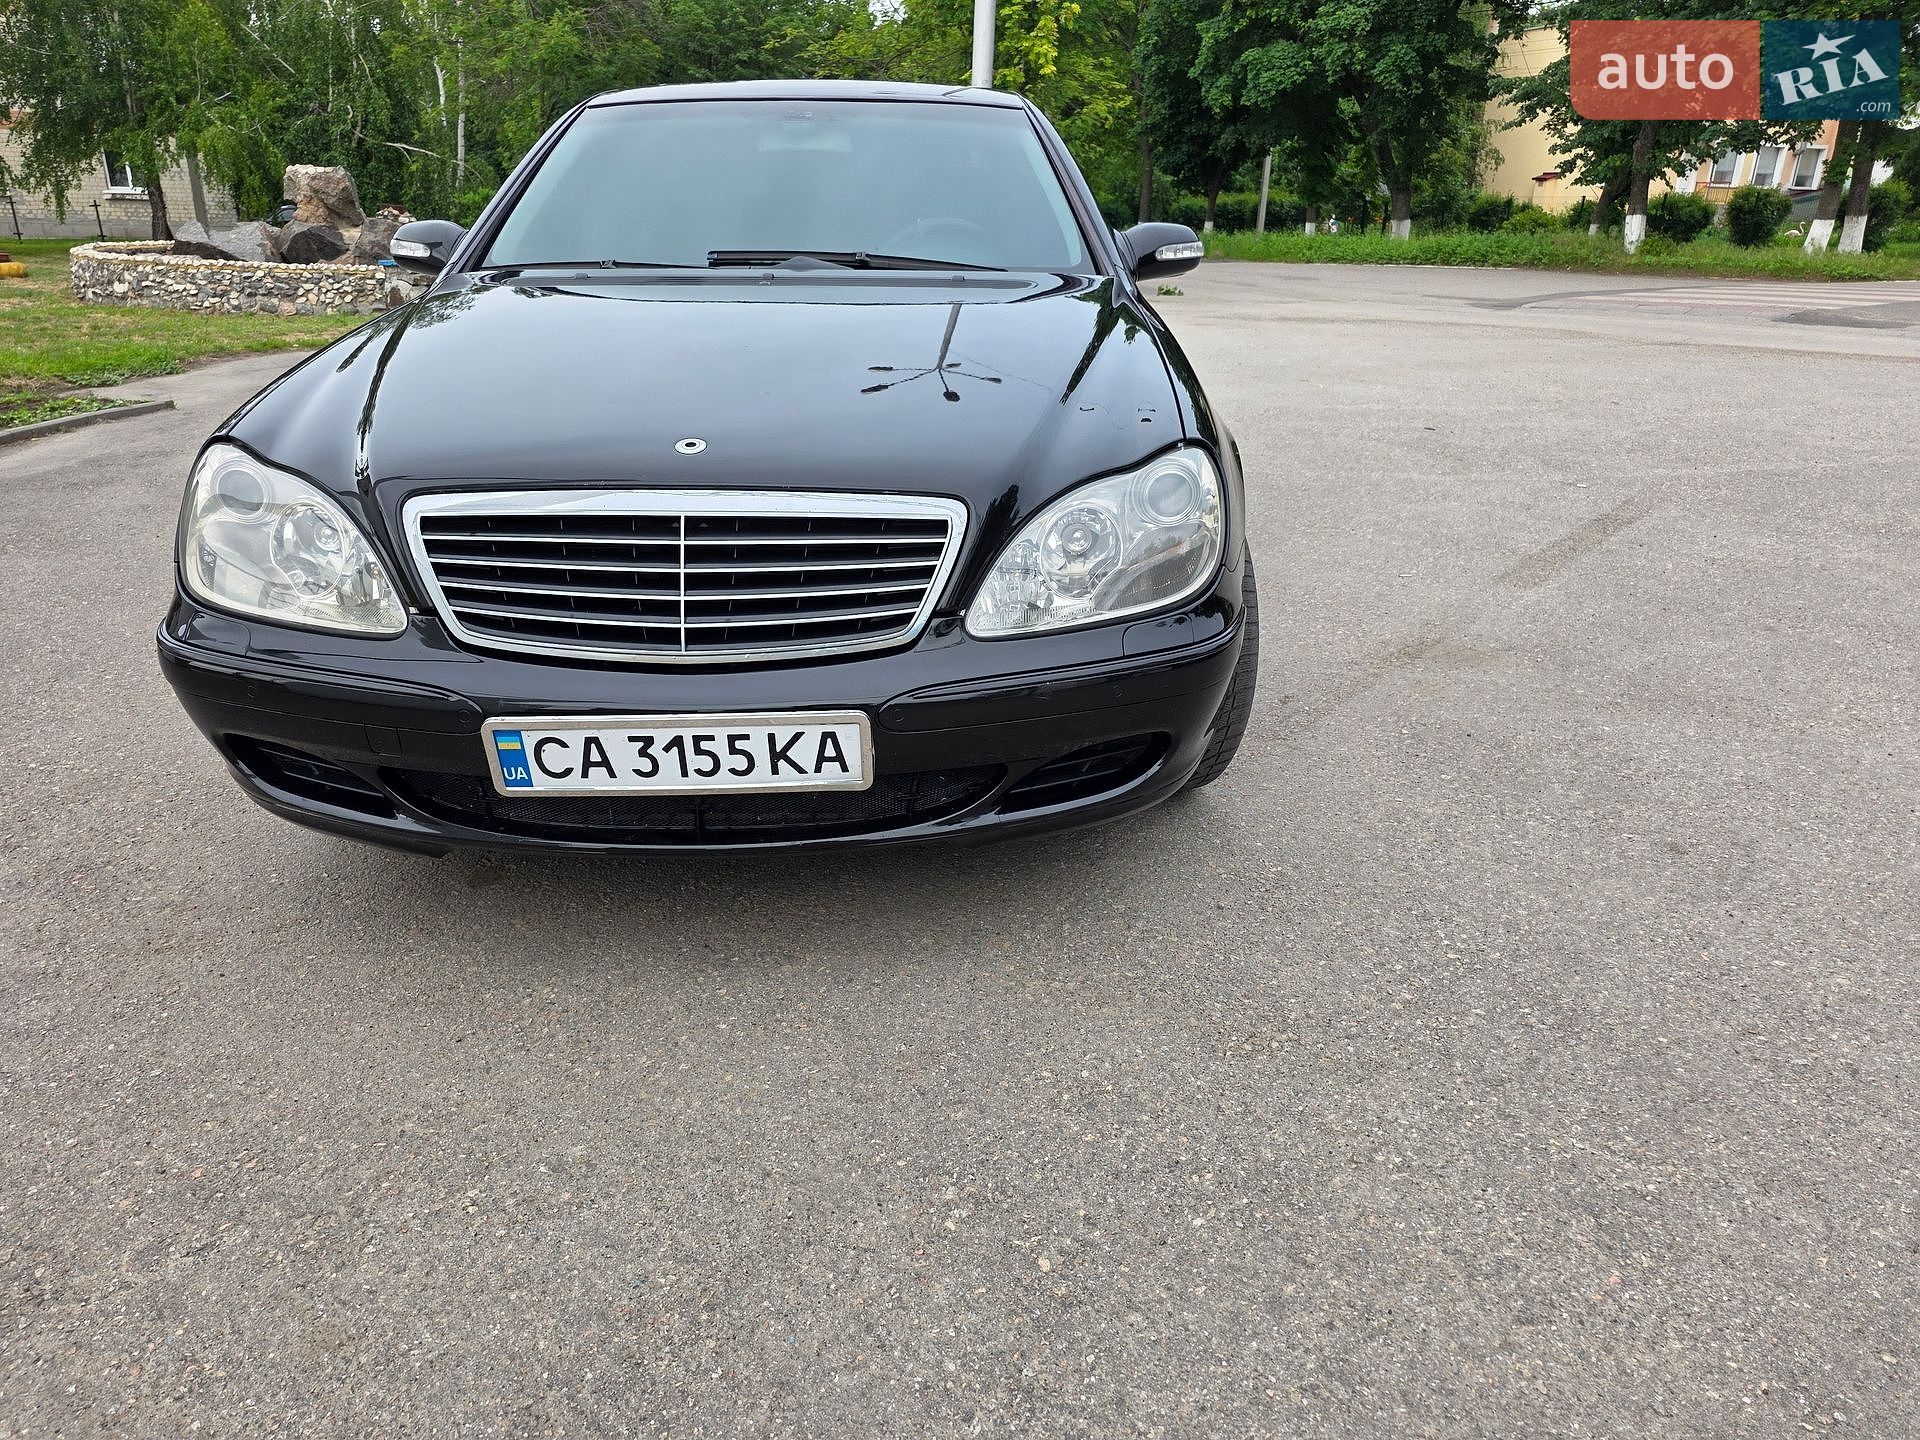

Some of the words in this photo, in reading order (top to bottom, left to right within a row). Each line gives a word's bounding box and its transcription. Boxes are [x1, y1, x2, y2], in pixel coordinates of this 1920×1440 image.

[533, 736, 617, 780] CA
[627, 734, 757, 778] 3155
[766, 731, 850, 776] KA
[503, 767, 529, 781] UA
